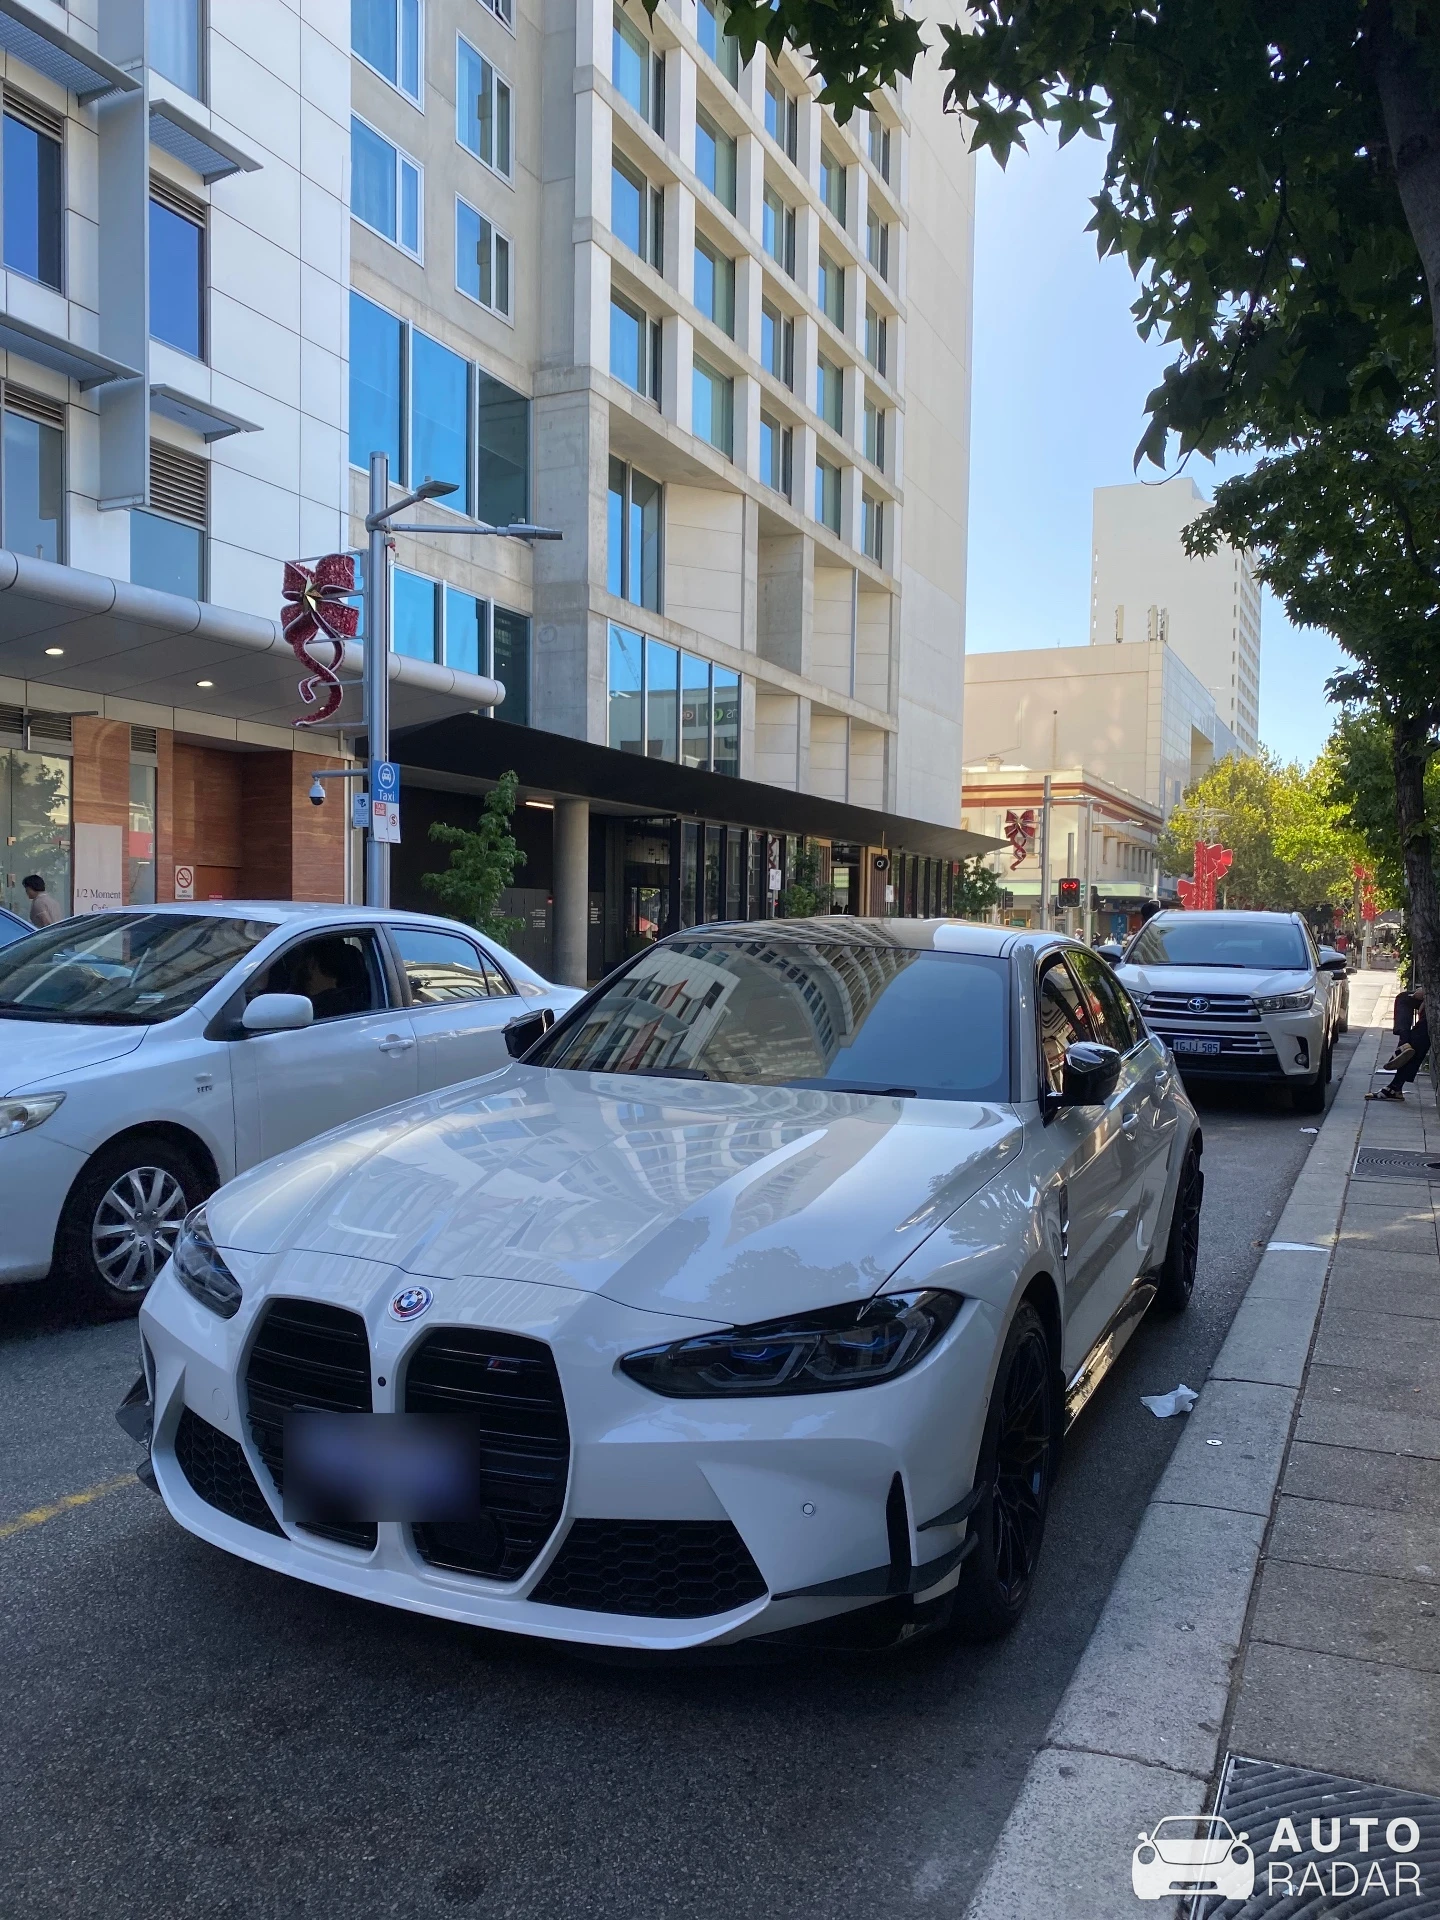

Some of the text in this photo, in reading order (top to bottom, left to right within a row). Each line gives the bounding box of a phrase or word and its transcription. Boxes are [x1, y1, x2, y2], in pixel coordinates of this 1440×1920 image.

[378, 789, 395, 801] Taxi
[76, 888, 121, 900] 1/2 Moment
[91, 903, 109, 912] Caf
[1175, 1041, 1219, 1053] 1GJJ 585
